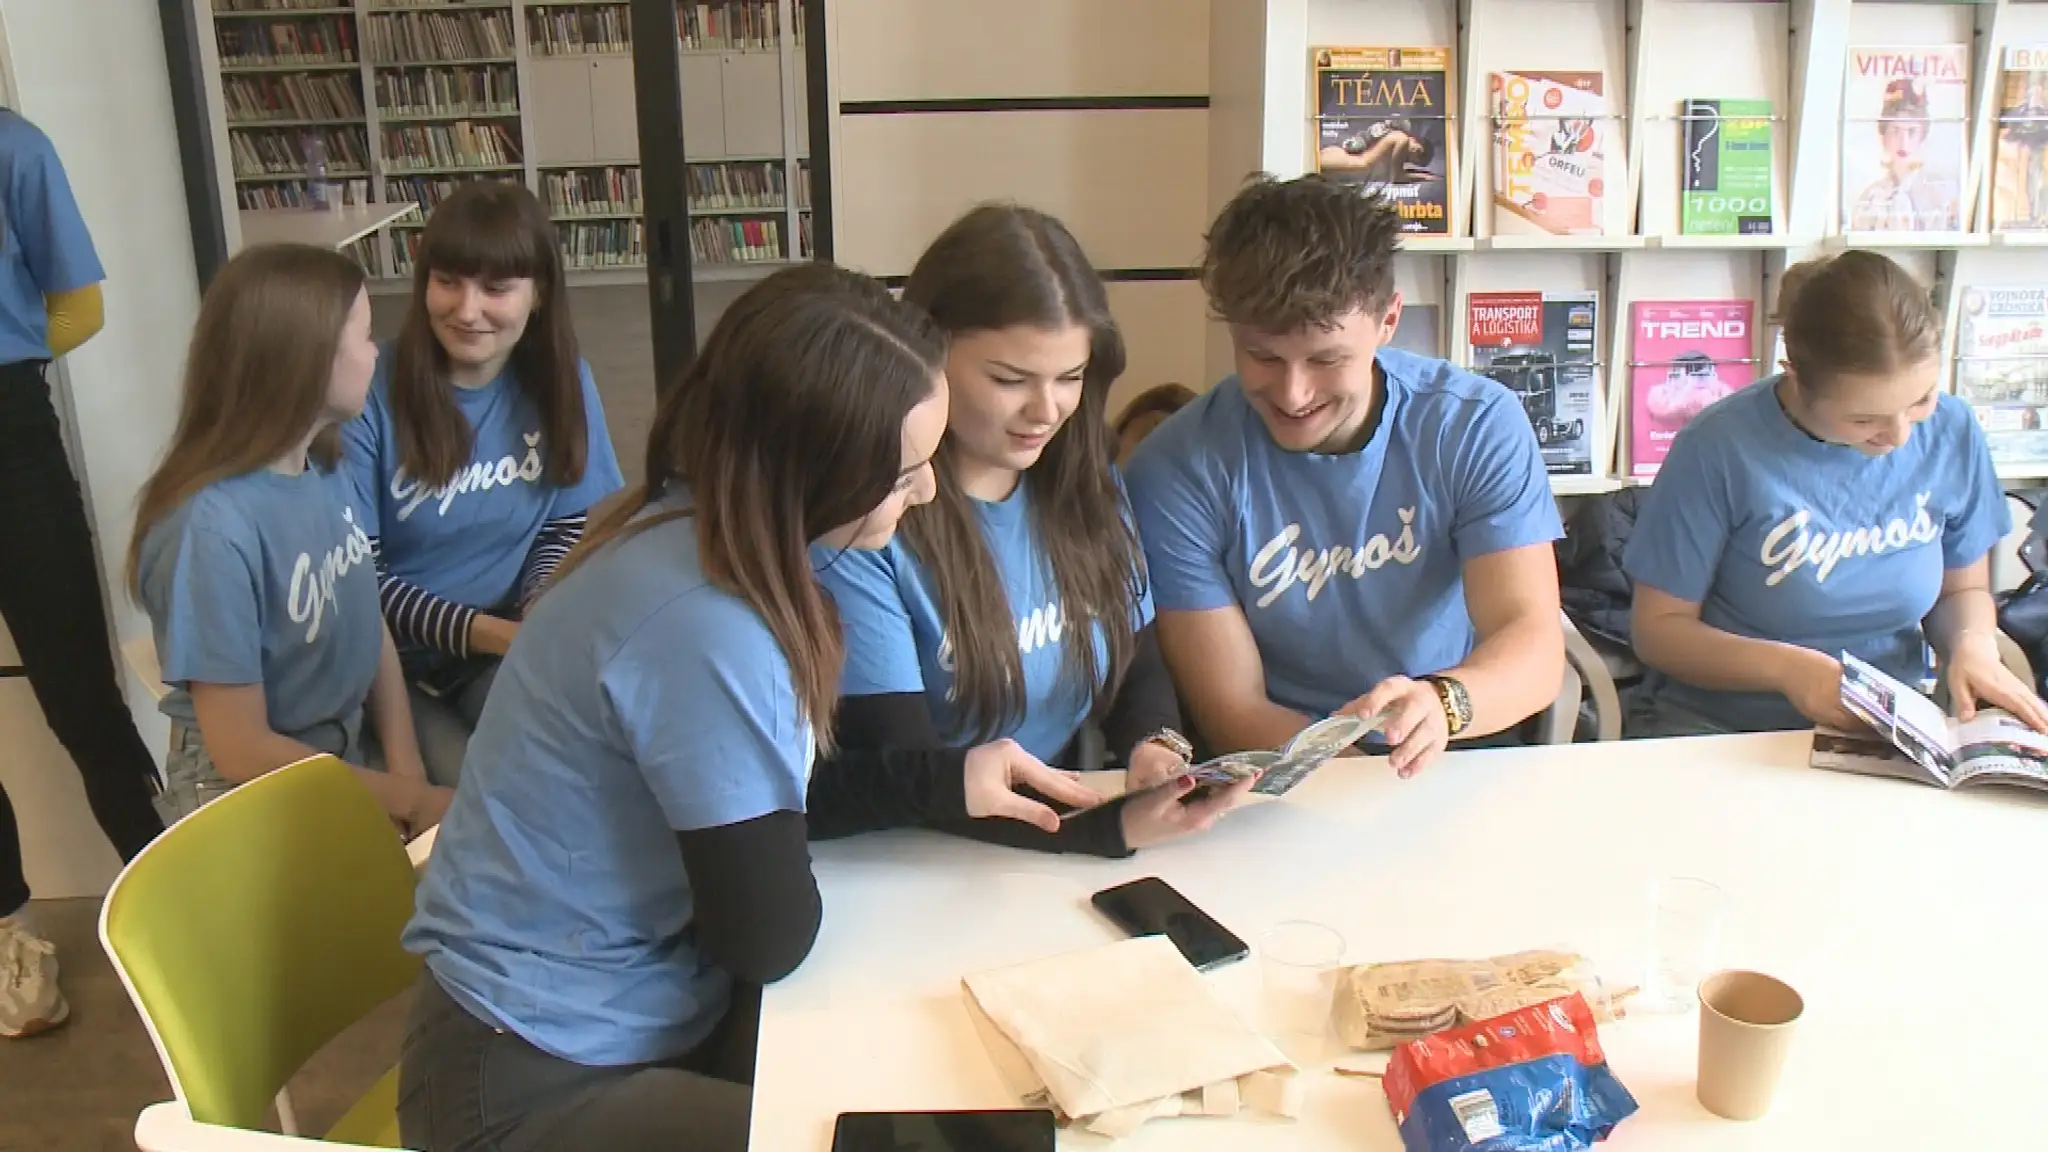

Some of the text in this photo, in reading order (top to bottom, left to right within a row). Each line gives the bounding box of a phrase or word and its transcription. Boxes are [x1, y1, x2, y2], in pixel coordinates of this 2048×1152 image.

[1857, 53, 1958, 77] VITALITA
[1331, 72, 1433, 107] TÉMA
[1548, 155, 1586, 177] ORFEU
[1690, 196, 1767, 213] 1000
[1472, 305, 1539, 321] TRANSPORT
[1472, 319, 1539, 336] A LOGISTIKA
[1640, 319, 1746, 339] TREND
[1761, 490, 1939, 587] Gymoš
[1250, 505, 1422, 609] Gymoš
